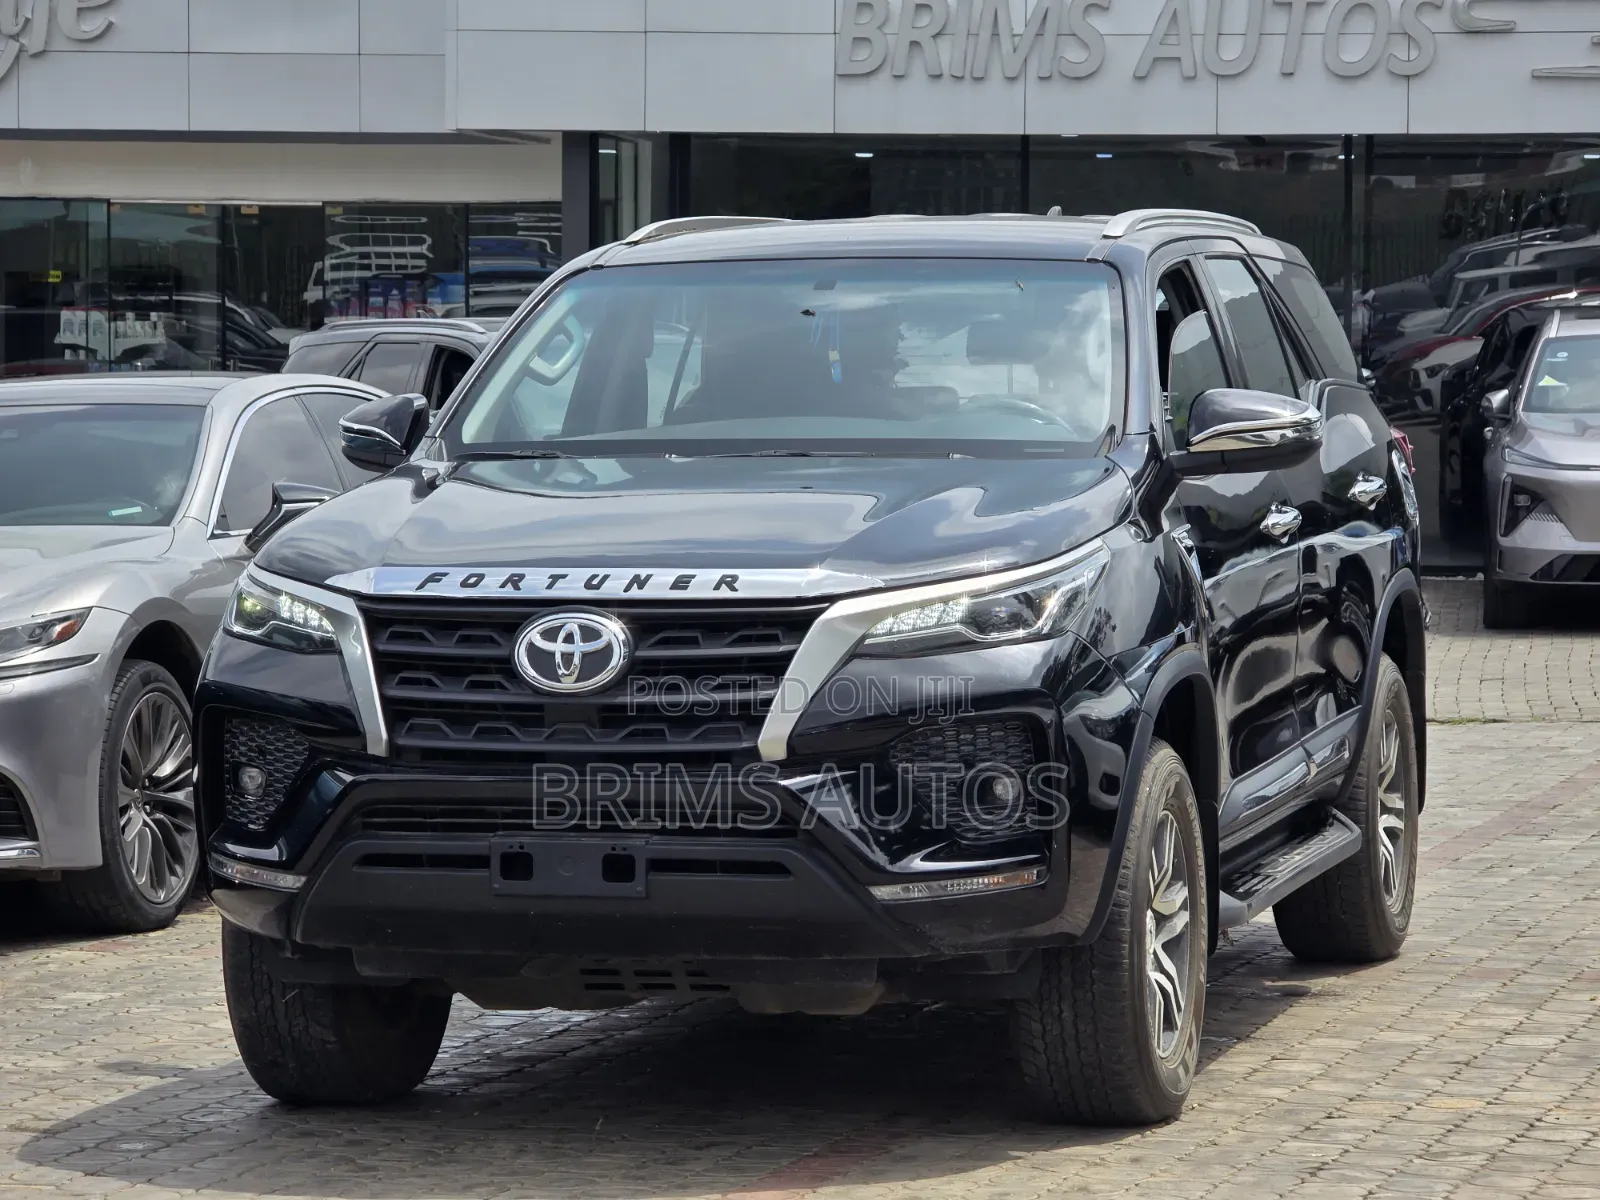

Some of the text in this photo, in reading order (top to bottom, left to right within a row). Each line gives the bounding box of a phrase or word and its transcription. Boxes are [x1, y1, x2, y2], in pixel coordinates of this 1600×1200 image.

[835, 0, 1445, 80] BRIMS AUTOS
[414, 571, 740, 594] FORTUNER
